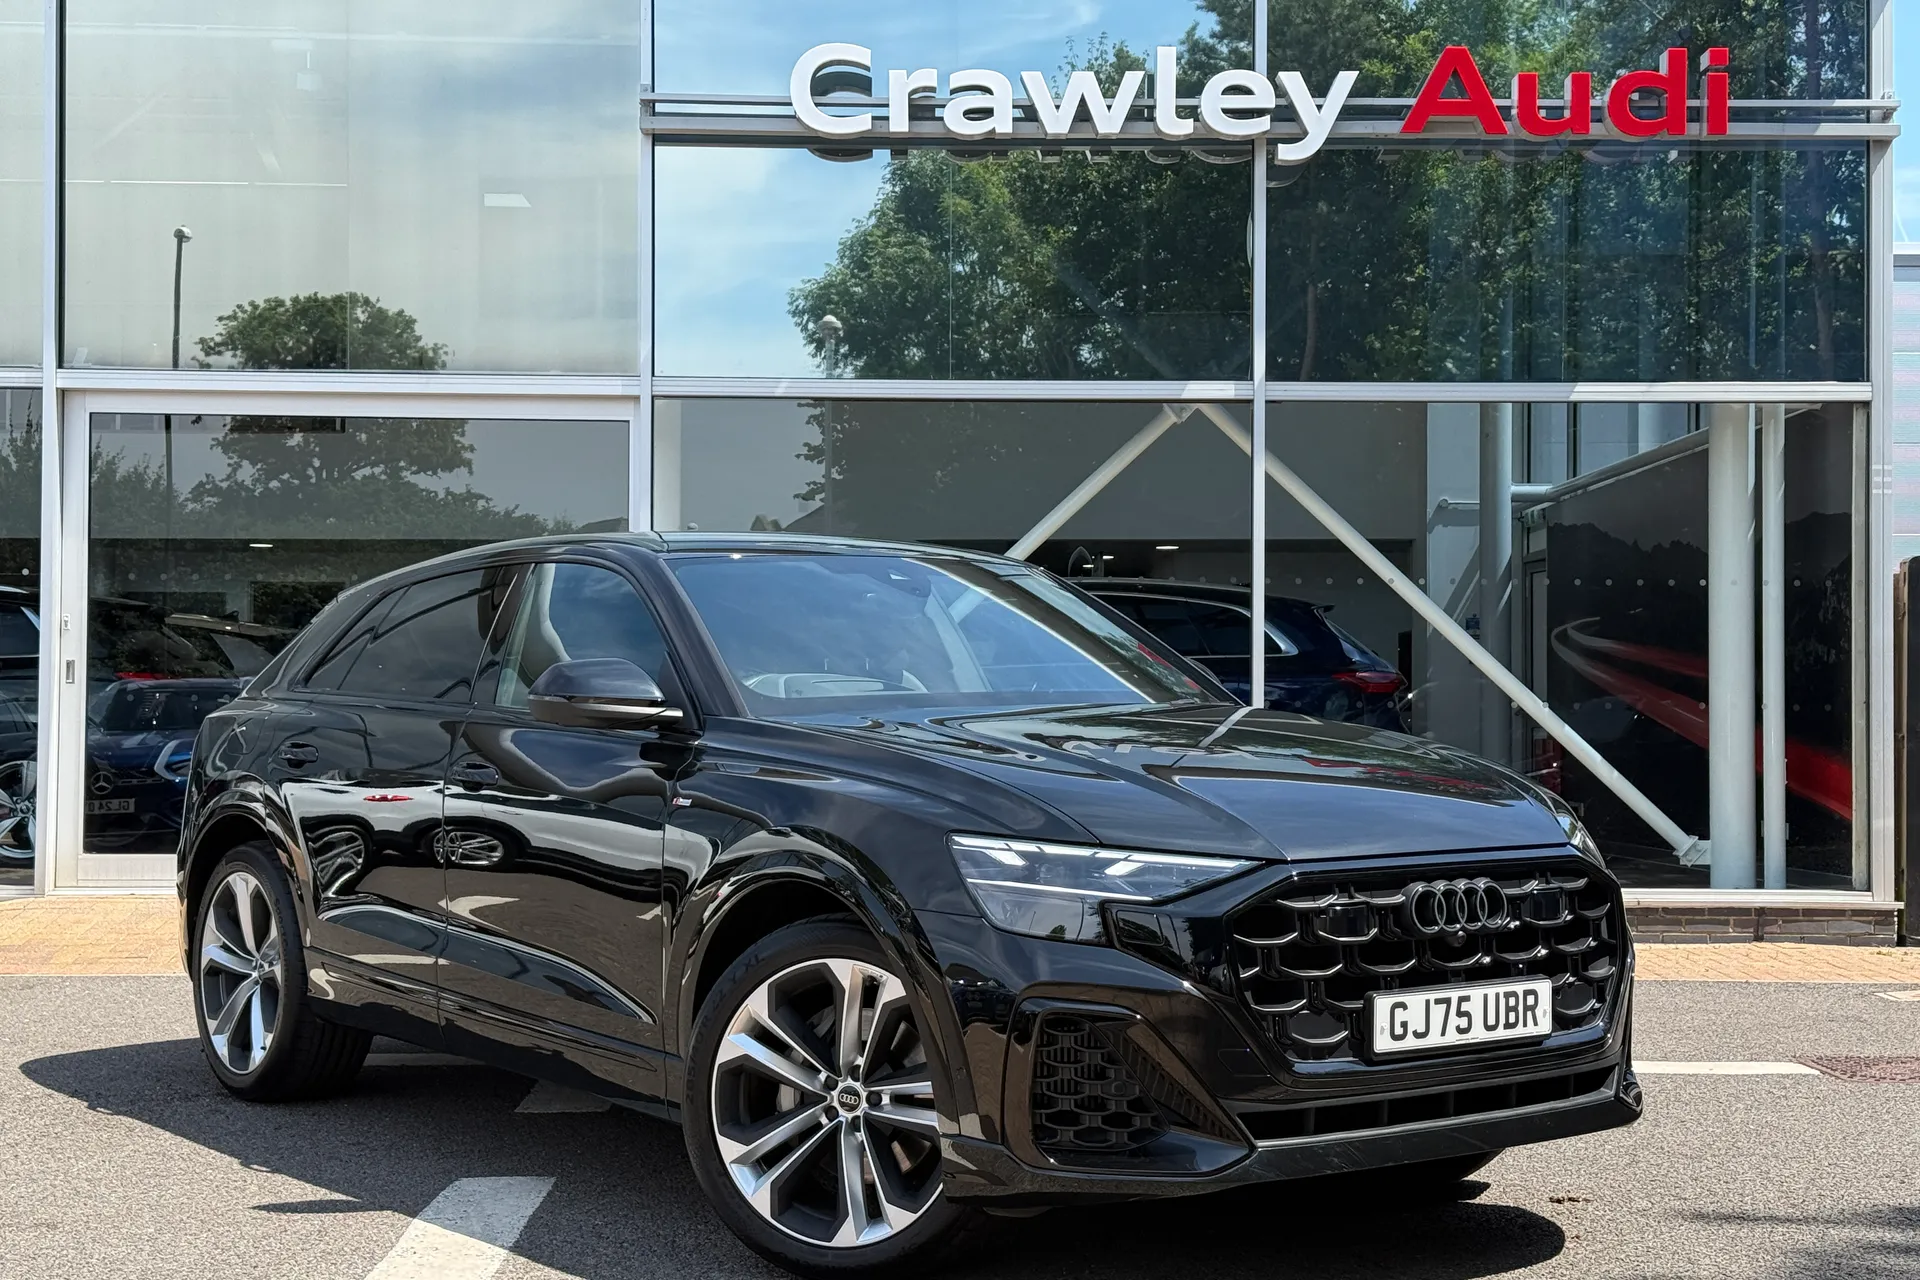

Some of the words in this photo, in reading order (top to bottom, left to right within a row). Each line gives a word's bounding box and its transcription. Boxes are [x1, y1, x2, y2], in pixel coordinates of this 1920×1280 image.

[789, 42, 1360, 163] Crawley
[1400, 45, 1729, 136] Audi
[1389, 994, 1473, 1042] GJ75
[1483, 988, 1539, 1032] UBR
